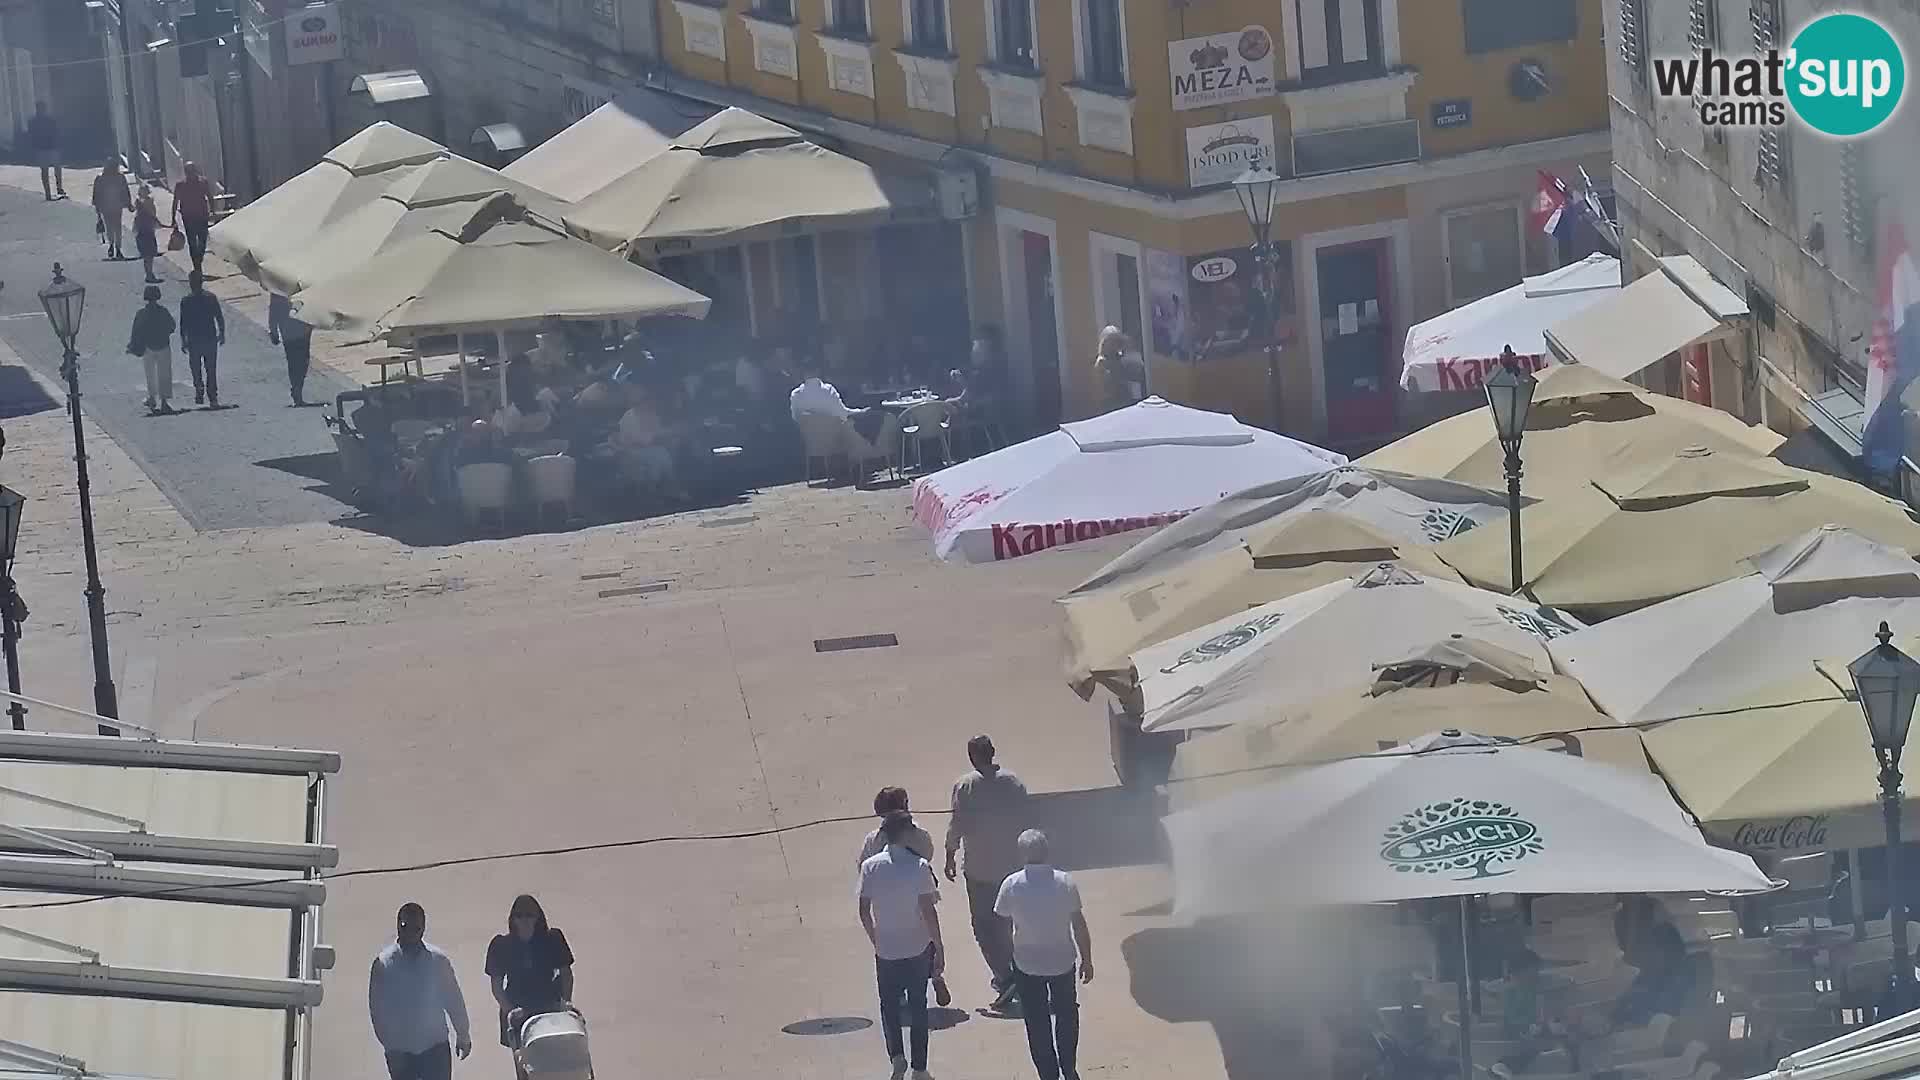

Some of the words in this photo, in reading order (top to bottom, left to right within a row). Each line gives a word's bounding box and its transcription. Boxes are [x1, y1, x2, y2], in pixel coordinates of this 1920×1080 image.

[1175, 65, 1253, 96] MEZA
[1193, 150, 1239, 169] ISPOD
[1419, 822, 1520, 854] RAUCH
